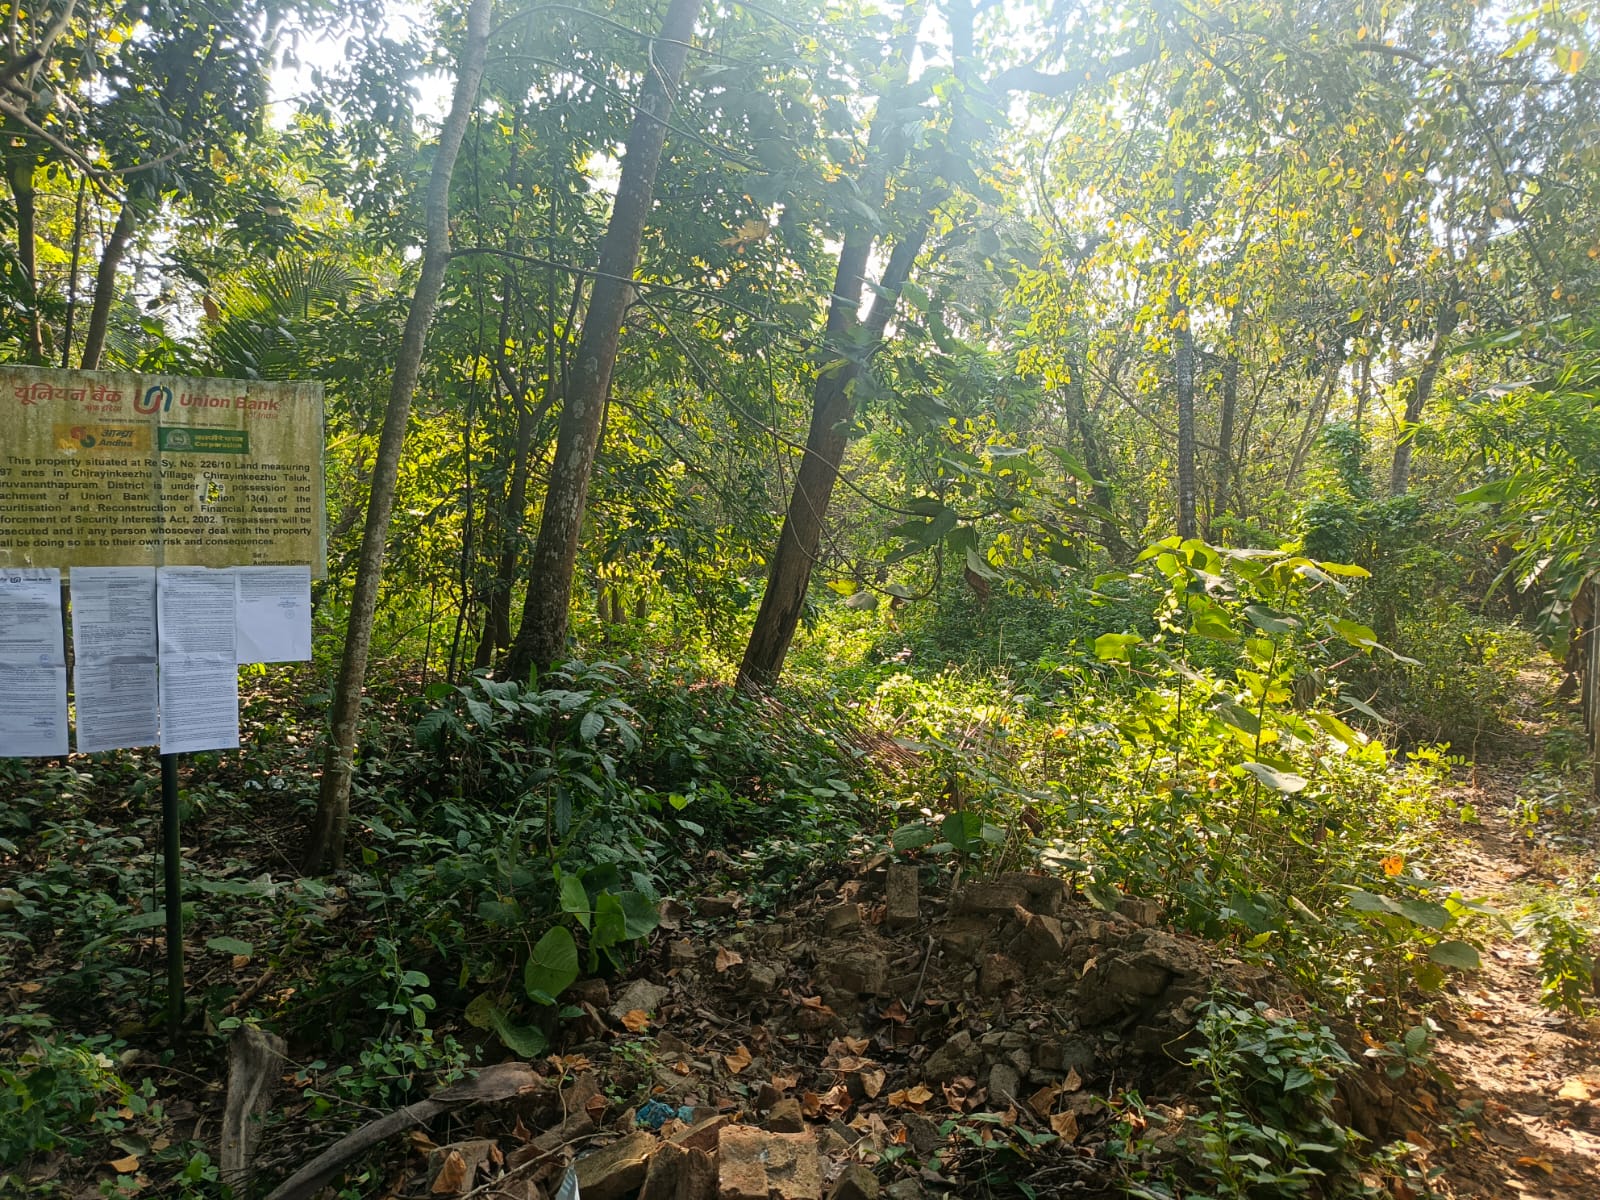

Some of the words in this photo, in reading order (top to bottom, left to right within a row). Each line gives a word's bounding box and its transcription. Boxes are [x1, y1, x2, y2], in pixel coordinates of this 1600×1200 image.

[14, 383, 87, 405] यूनियन
[92, 385, 123, 402] बैंक
[180, 393, 231, 408] Union
[236, 396, 280, 411] Bank
[99, 439, 133, 447] Andhra
[7, 456, 31, 465] This
[35, 457, 81, 467] property
[86, 457, 127, 466] situated
[131, 459, 140, 467] at
[144, 458, 157, 467] Re
[161, 459, 176, 468] Sy.
[180, 460, 196, 468] No.
[200, 461, 231, 469] 226/10
[235, 461, 258, 470] Land
[261, 463, 310, 472] measuring
[53, 468, 63, 477] in
[71, 468, 152, 480] Chirayinkeezhu
[160, 470, 195, 480] Village,
[203, 471, 276, 481] Chirayinkeezhu
[107, 480, 144, 489] District
[153, 481, 162, 489] is
[171, 482, 199, 490] under
[232, 484, 286, 493] possession
[294, 484, 310, 492] and
[59, 492, 69, 500] of
[81, 492, 112, 500] Union
[123, 492, 150, 501] Bank
[160, 493, 189, 501] under
[199, 494, 235, 502] stion
[246, 494, 268, 503] 13(4)
[277, 495, 287, 503] of
[296, 495, 310, 503] the
[70, 503, 89, 512] and
[98, 503, 176, 512] Reconstruction
[184, 504, 193, 512] of
[201, 504, 244, 513] Financial
[294, 506, 311, 514] and
[60, 515, 71, 523] of
[75, 515, 118, 525] Security
[122, 515, 166, 524] Interests
[170, 515, 189, 524] Act,
[193, 515, 218, 524] 2002.
[222, 516, 278, 525] Trespassers
[282, 516, 297, 524] will
[53, 527, 73, 535] and
[77, 527, 84, 535] if
[88, 528, 107, 536] any
[111, 527, 147, 536] person
[150, 527, 205, 535] whosoever
[208, 526, 228, 535] deal
[232, 527, 251, 535] with
[255, 527, 270, 535] the
[273, 527, 312, 537] property
[17, 539, 30, 547] be
[33, 539, 64, 549] doing
[68, 539, 81, 547] so
[112, 538, 136, 546] their
[163, 538, 181, 546] risk
[185, 538, 203, 546] and
[206, 538, 277, 547] consequences.
